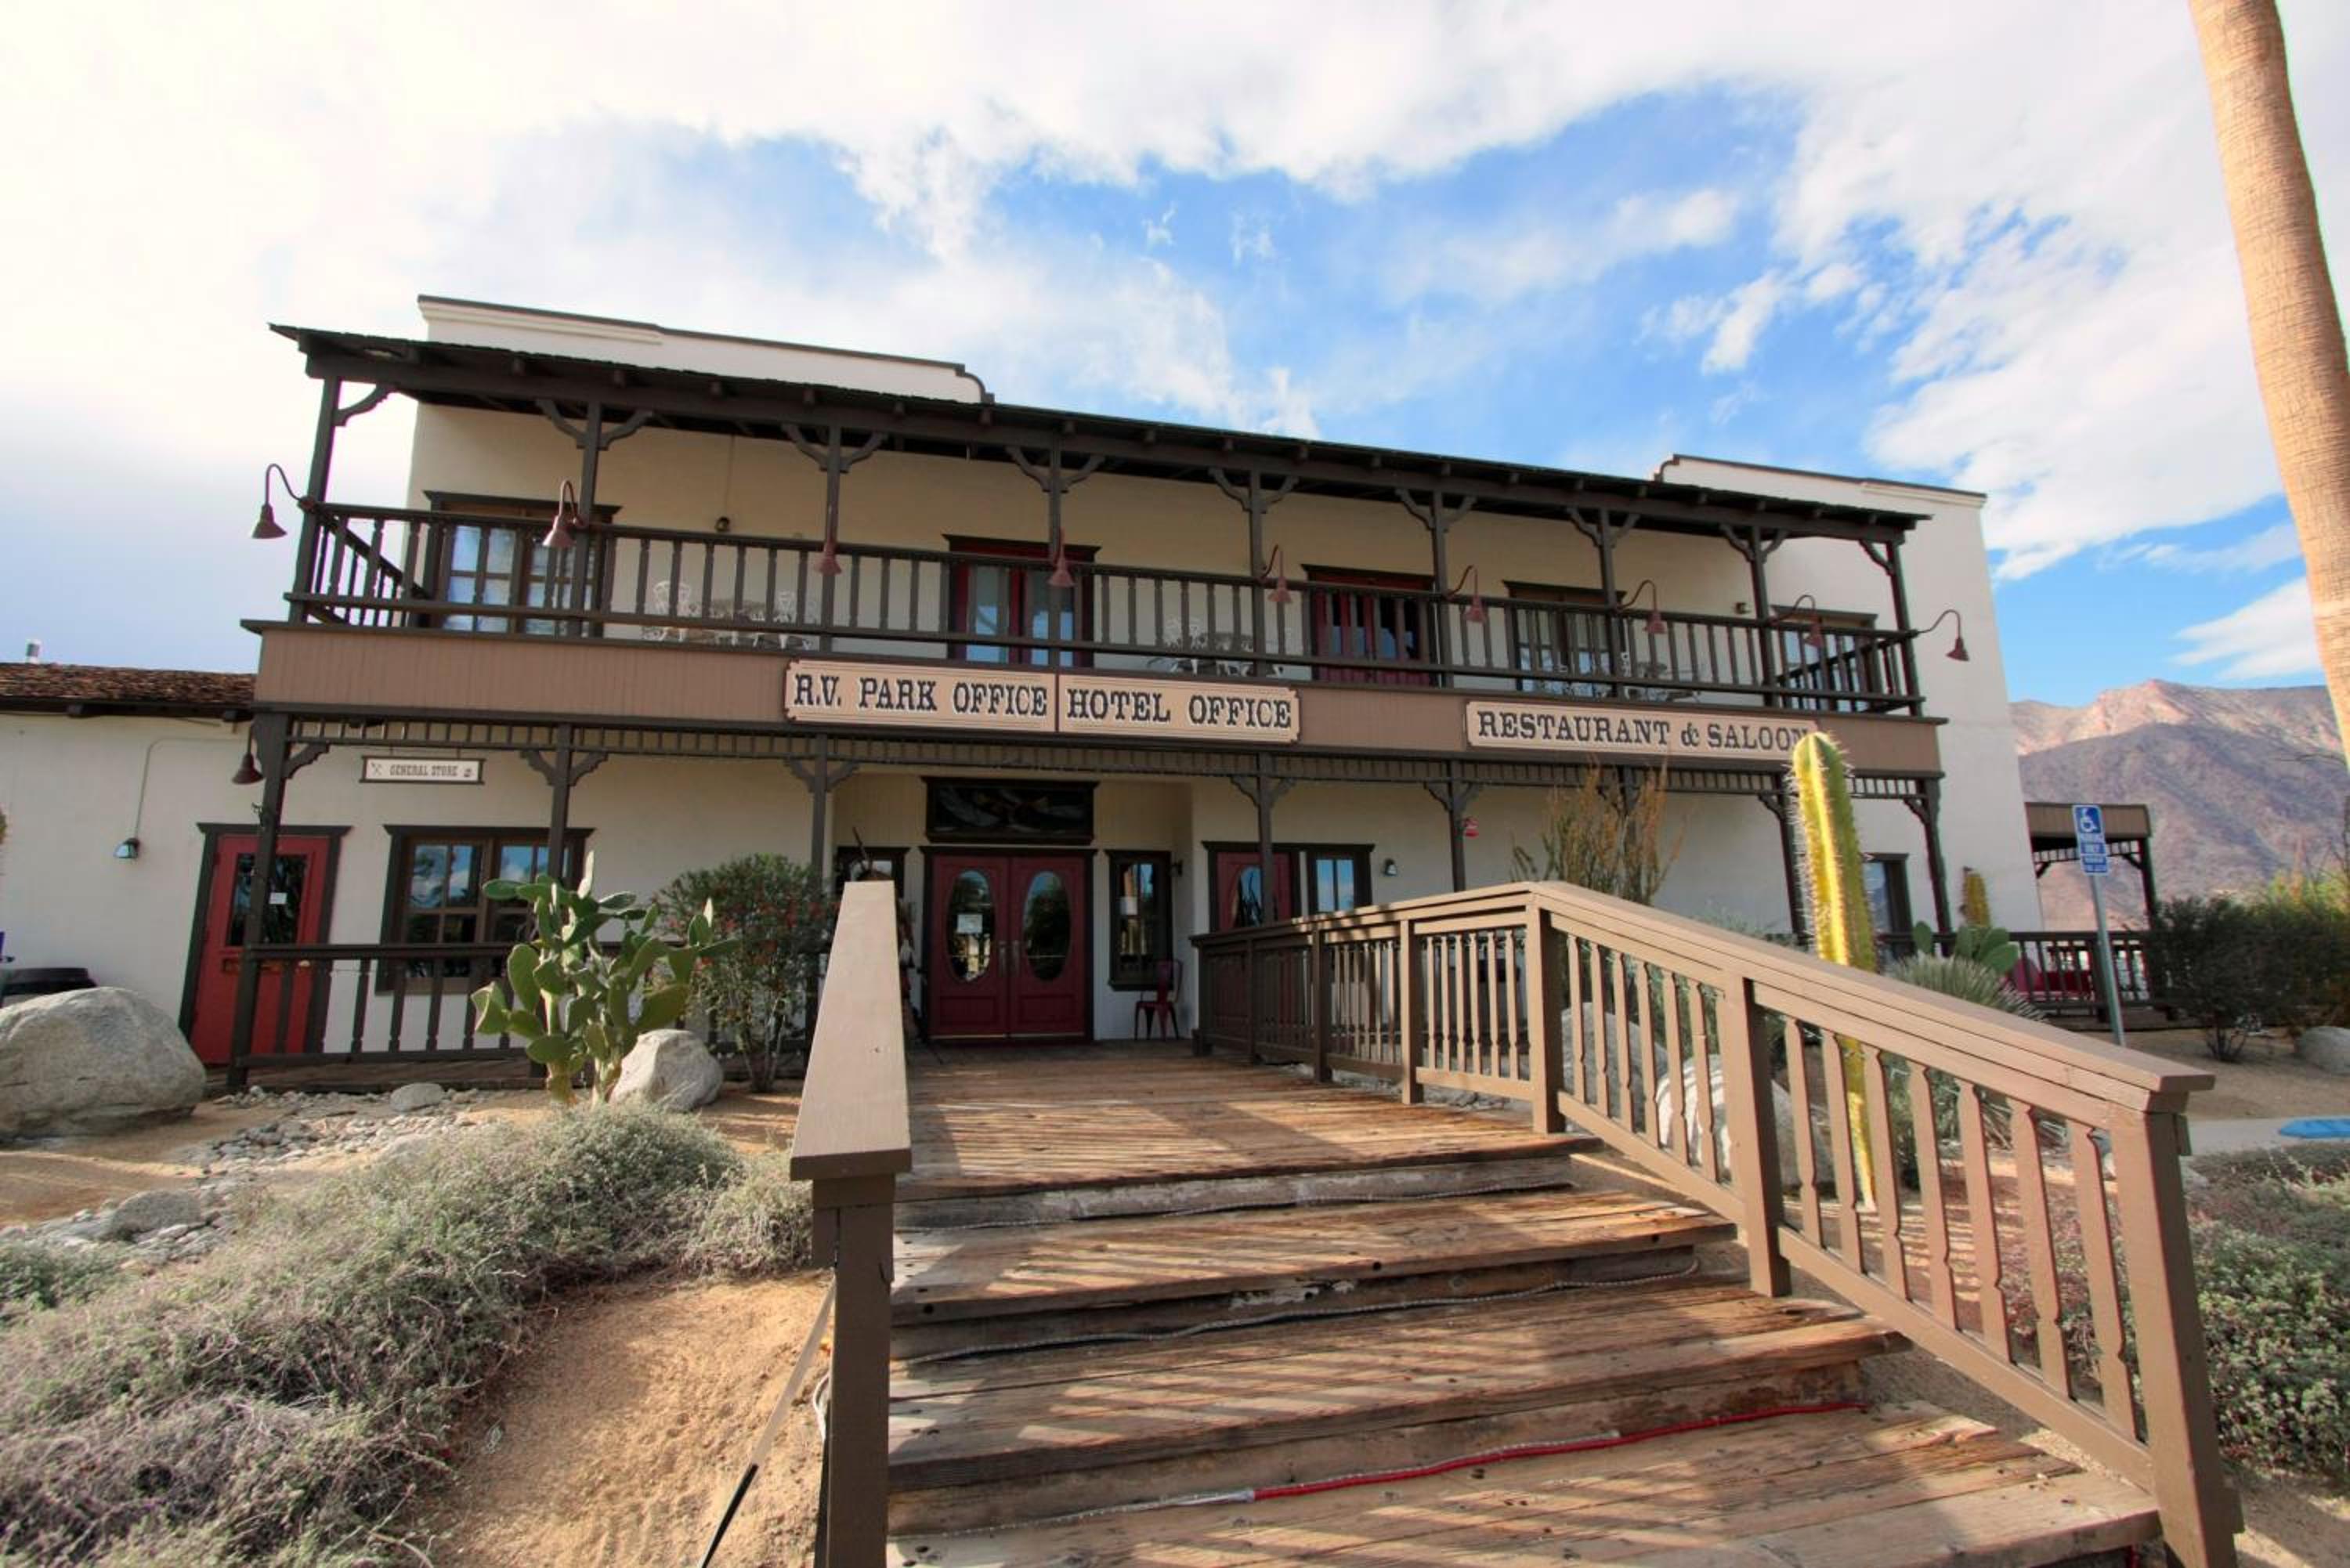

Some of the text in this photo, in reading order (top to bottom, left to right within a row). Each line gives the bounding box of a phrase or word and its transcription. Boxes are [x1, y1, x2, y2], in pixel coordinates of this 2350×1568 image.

[794, 674, 1047, 716] R.V. PARK OFFICE
[1067, 688, 1291, 728] HOTEL OFFICE
[1477, 710, 1670, 745] RESTAURANT
[1681, 722, 1699, 746] &
[389, 764, 458, 776] GENERAL STORE
